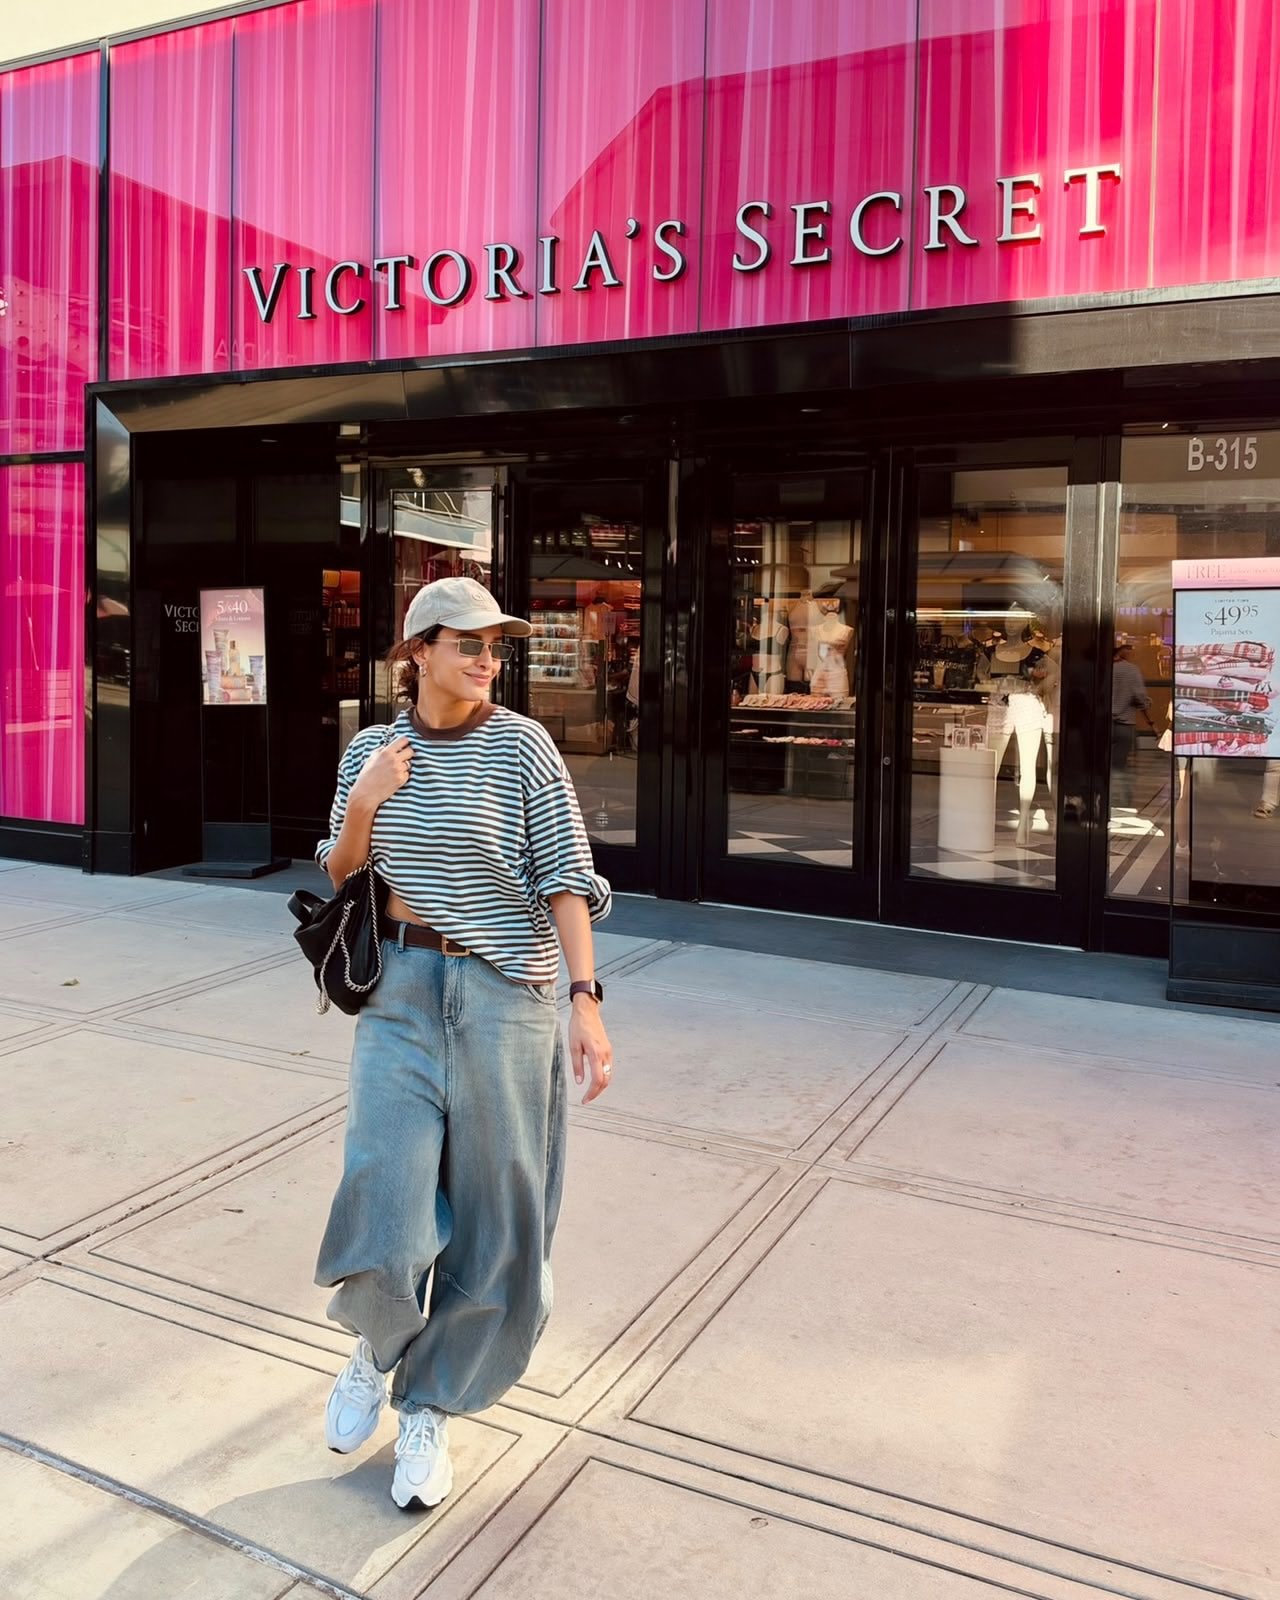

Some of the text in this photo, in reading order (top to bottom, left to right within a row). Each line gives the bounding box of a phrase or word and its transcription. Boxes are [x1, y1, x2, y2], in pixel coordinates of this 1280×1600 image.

[243, 162, 1122, 323] VICTORIA'S SECRET
[1187, 436, 1258, 471] B-315
[1186, 563, 1226, 579] FREE
[1210, 628, 1237, 636] Pajama
